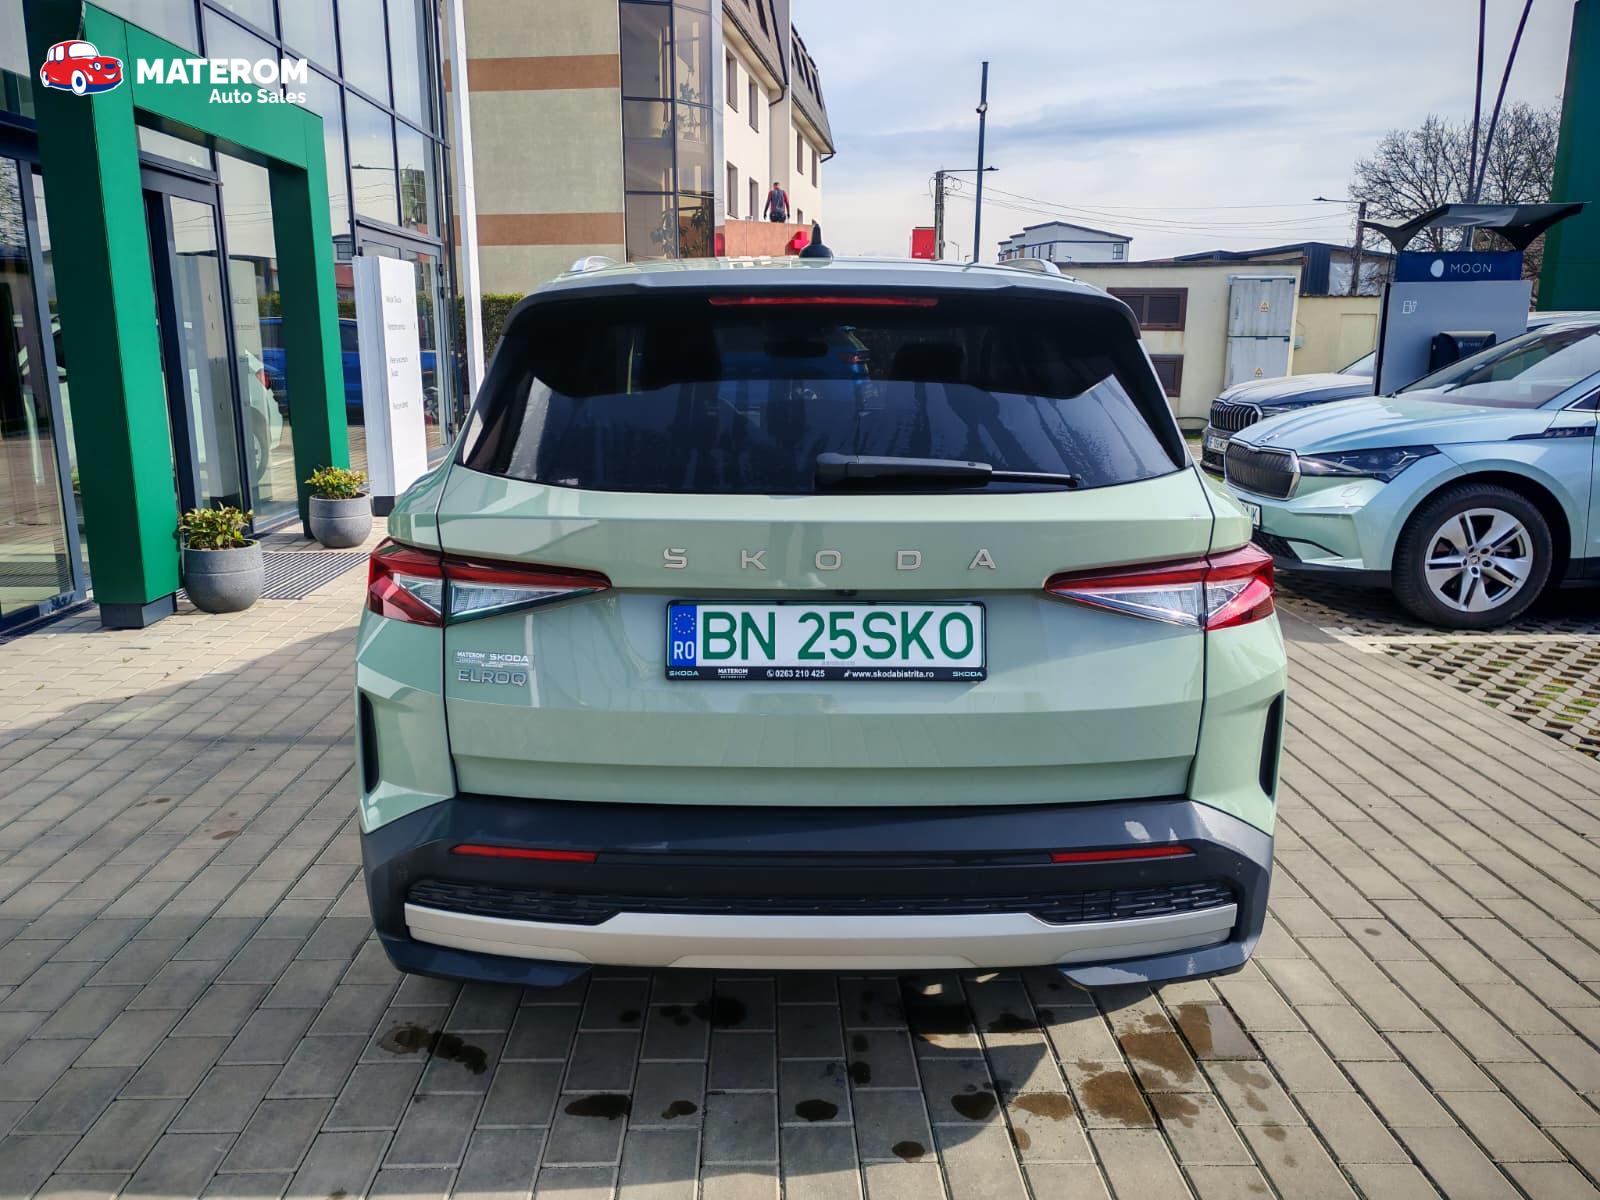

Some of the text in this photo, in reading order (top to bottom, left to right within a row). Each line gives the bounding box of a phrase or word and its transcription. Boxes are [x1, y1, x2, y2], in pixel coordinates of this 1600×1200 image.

[1450, 263, 1492, 274] MOON
[702, 611, 776, 661] BN
[673, 640, 695, 660] RO
[489, 653, 529, 663] SKODA
[458, 669, 528, 687] ELROQ
[775, 669, 825, 678] 0263 210 425
[852, 669, 934, 678] www.skodabistrita.ro
